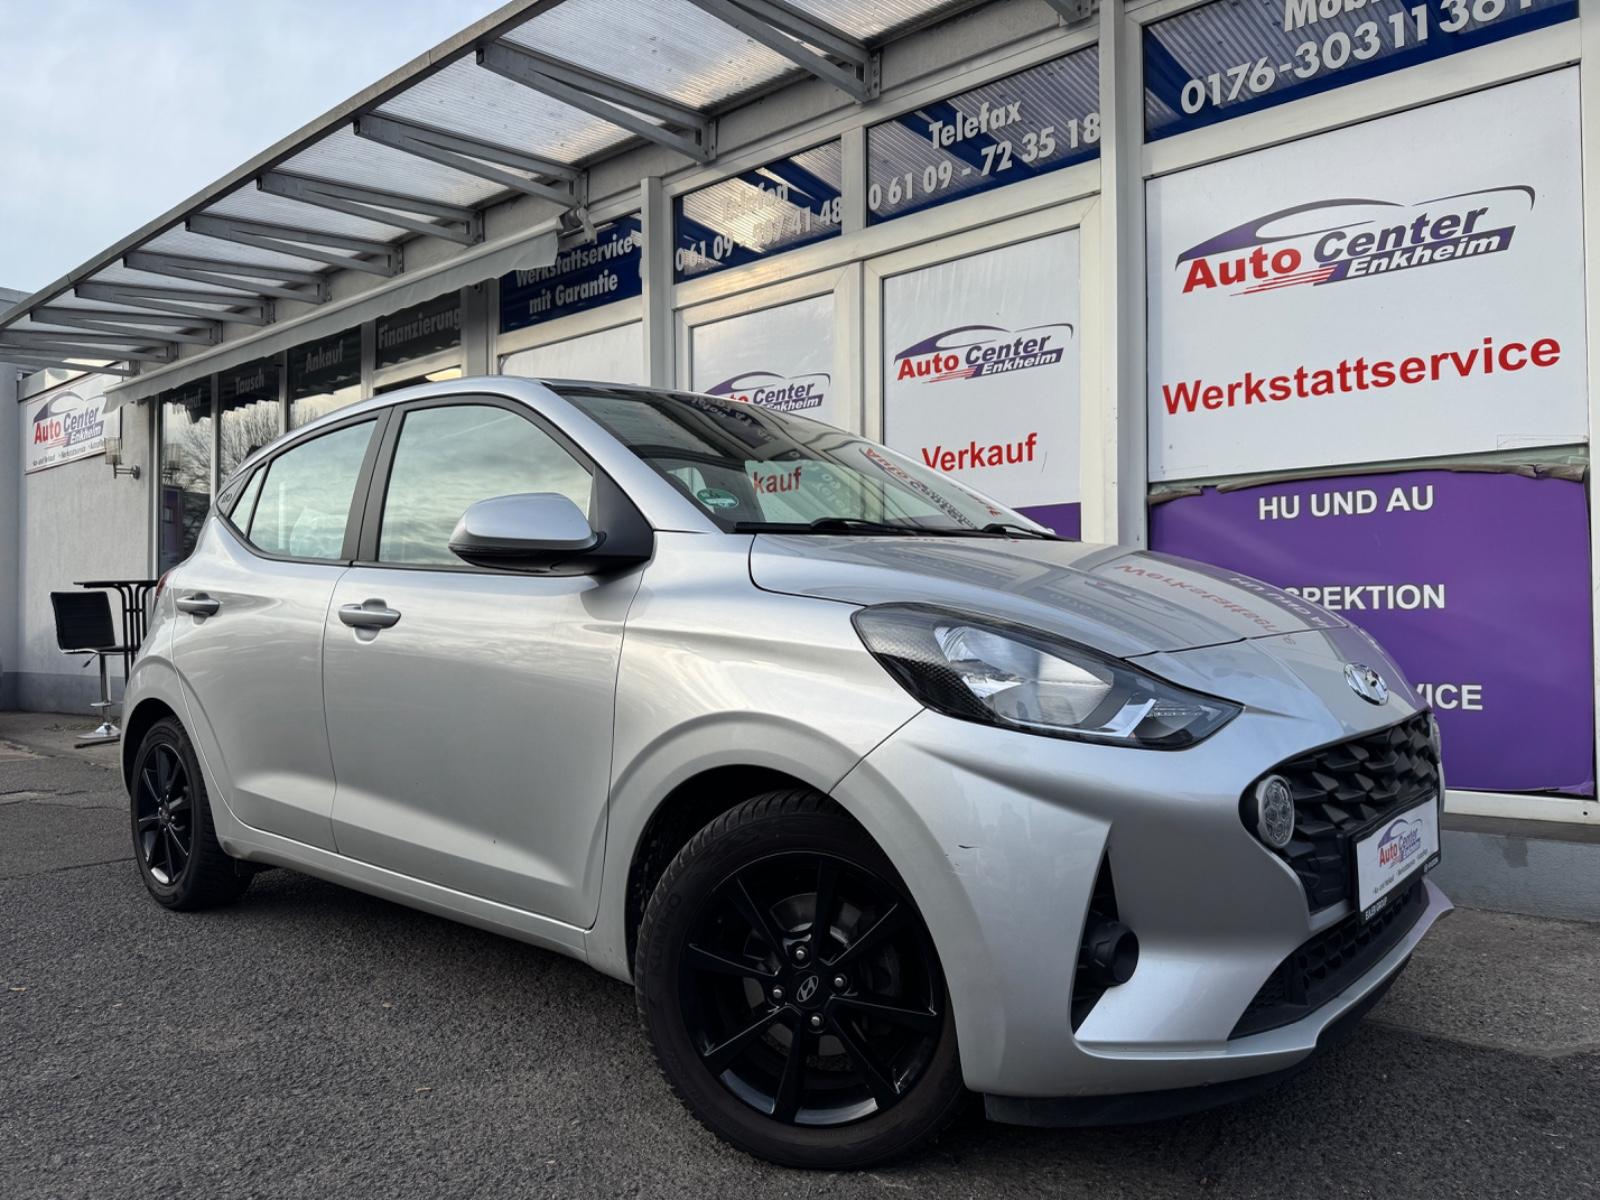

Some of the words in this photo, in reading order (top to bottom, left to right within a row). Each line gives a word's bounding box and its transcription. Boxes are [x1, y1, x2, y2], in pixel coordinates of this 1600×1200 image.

[1283, 0, 1380, 32] Mo
[1439, 0, 1532, 33] 36
[928, 100, 1022, 149] Telefax
[868, 183, 879, 210] 0
[888, 172, 913, 204] 61
[923, 160, 952, 194] 09
[981, 141, 1013, 177] 72
[1022, 126, 1056, 163] 35
[1068, 112, 1100, 149] 18
[675, 247, 684, 272] 0
[689, 240, 706, 267] 61
[713, 232, 734, 260] 09
[791, 206, 811, 235] 41
[820, 196, 843, 226] 48
[1182, 245, 1302, 294] Auto
[1313, 206, 1489, 264] Center
[516, 234, 634, 288] Werkstattservice
[1346, 232, 1501, 279] Enkheim
[529, 288, 552, 314] mit
[555, 269, 619, 307] Garantie
[378, 307, 462, 350] Finanzierung
[305, 338, 345, 373] Ankauf
[896, 353, 960, 381] Auto
[964, 332, 1052, 365] Center
[981, 350, 1058, 376] Enkheim
[1162, 336, 1561, 416] Werkstattservice
[234, 368, 265, 396] Tausch
[753, 382, 816, 405] Center
[34, 420, 62, 445] Auto
[63, 407, 99, 432] Center
[921, 432, 1037, 472] Verkauf
[1259, 495, 1300, 520] HU
[1311, 489, 1378, 518] UND
[1385, 485, 1434, 513] AU
[1379, 842, 1398, 866] Auto
